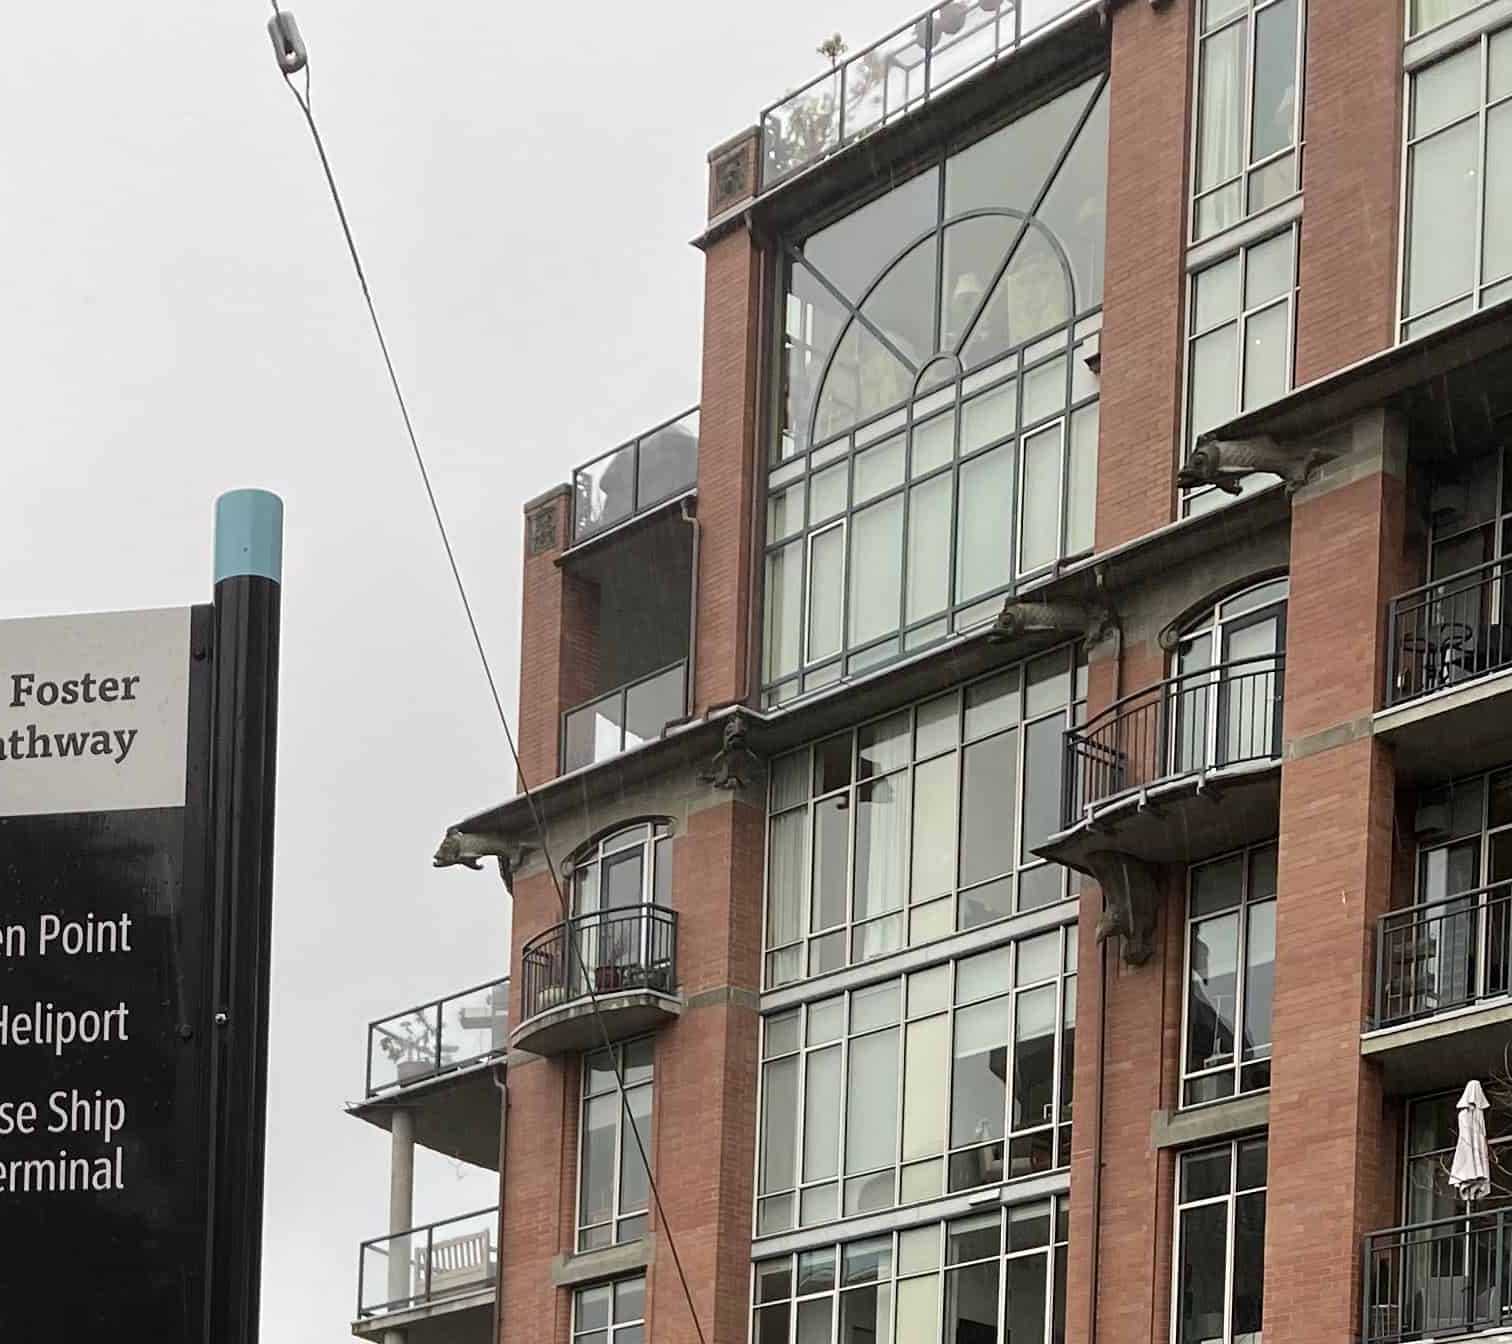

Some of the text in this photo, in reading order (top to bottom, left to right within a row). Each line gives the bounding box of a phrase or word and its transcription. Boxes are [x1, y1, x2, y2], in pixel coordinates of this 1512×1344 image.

[10, 672, 140, 708] Foster
[39, 912, 132, 956] Point
[47, 1089, 126, 1143] Ship
